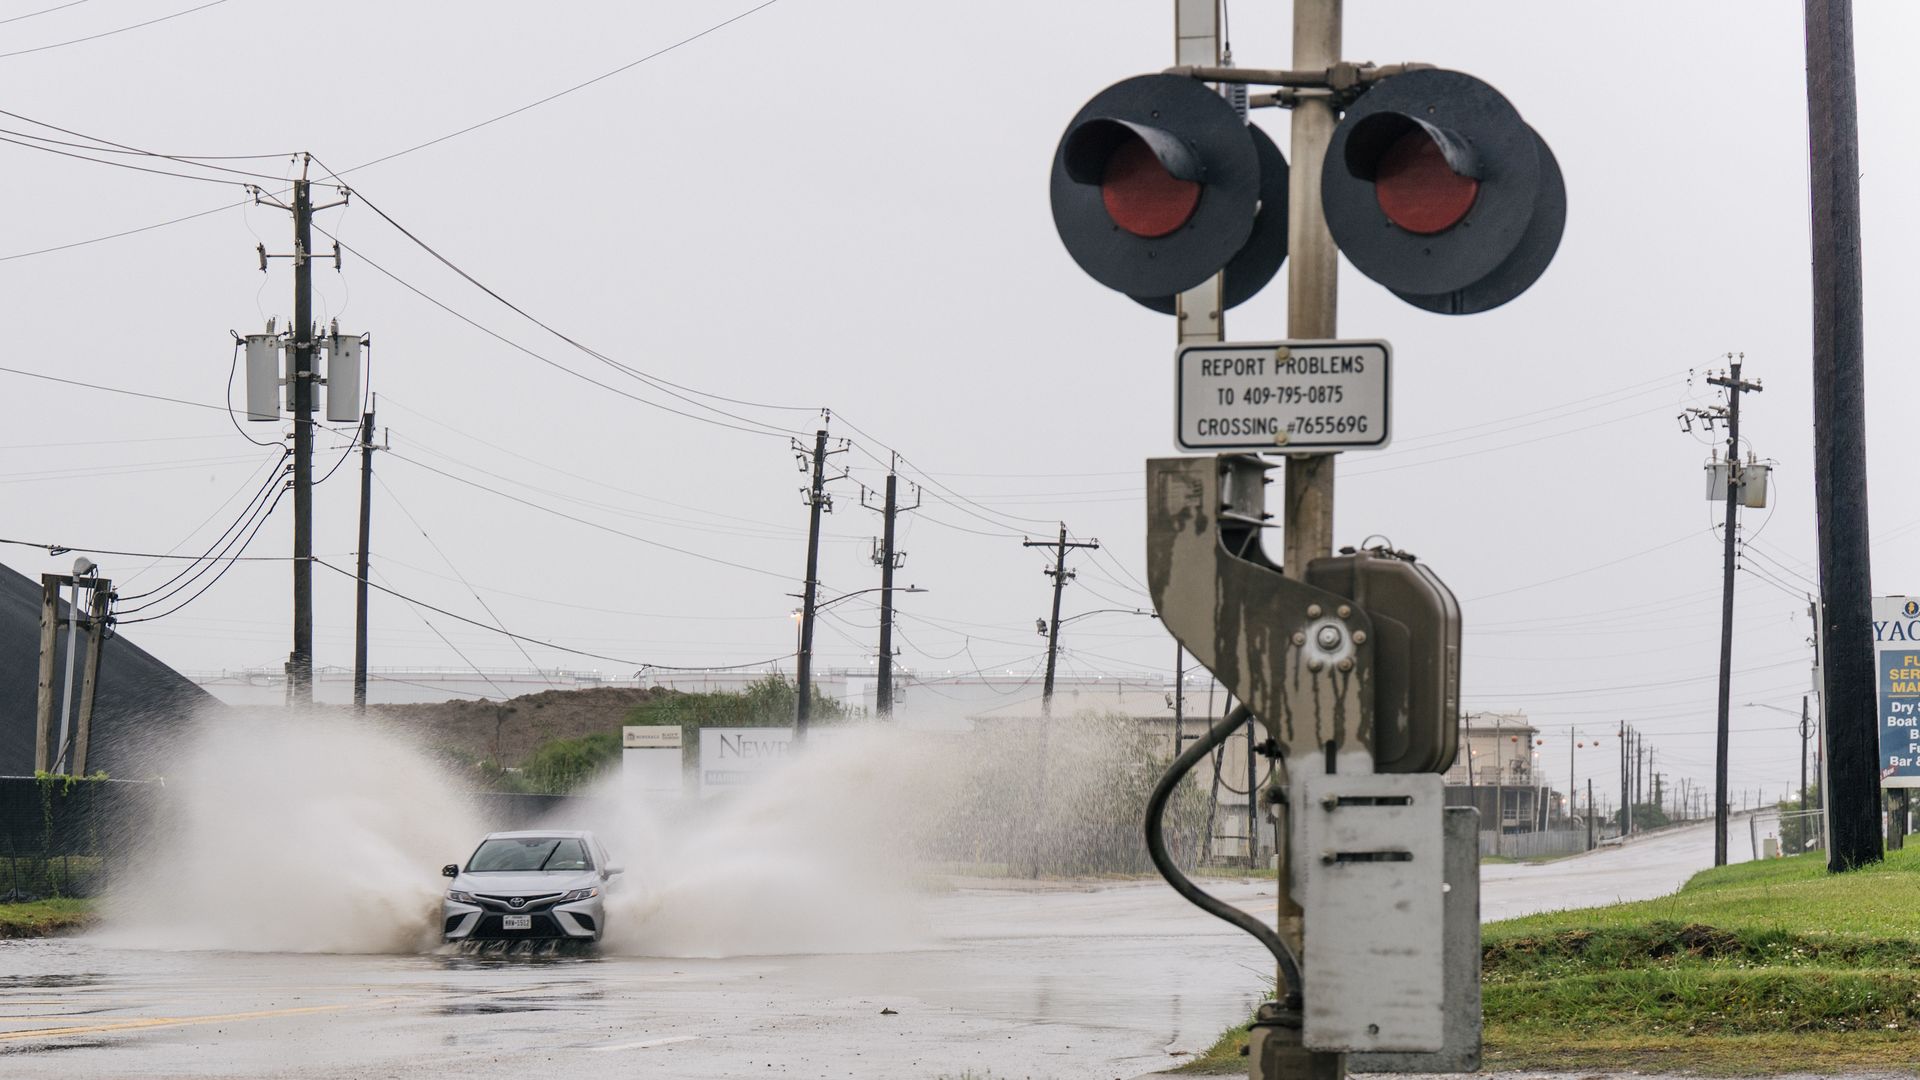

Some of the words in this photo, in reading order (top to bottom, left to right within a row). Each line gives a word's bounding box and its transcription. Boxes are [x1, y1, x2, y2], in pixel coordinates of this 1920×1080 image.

[1202, 358, 1266, 376] REPORT
[1275, 356, 1364, 375] PROBLEMS
[1218, 388, 1234, 405] TO
[1243, 385, 1343, 405] 409-795-0875
[1197, 417, 1278, 436] CROSSING
[1287, 415, 1367, 434] #765569G
[1892, 682, 1920, 692] MA
[1891, 702, 1914, 715] Dry
[1887, 716, 1917, 727] Boat
[1890, 756, 1912, 767] Bar
